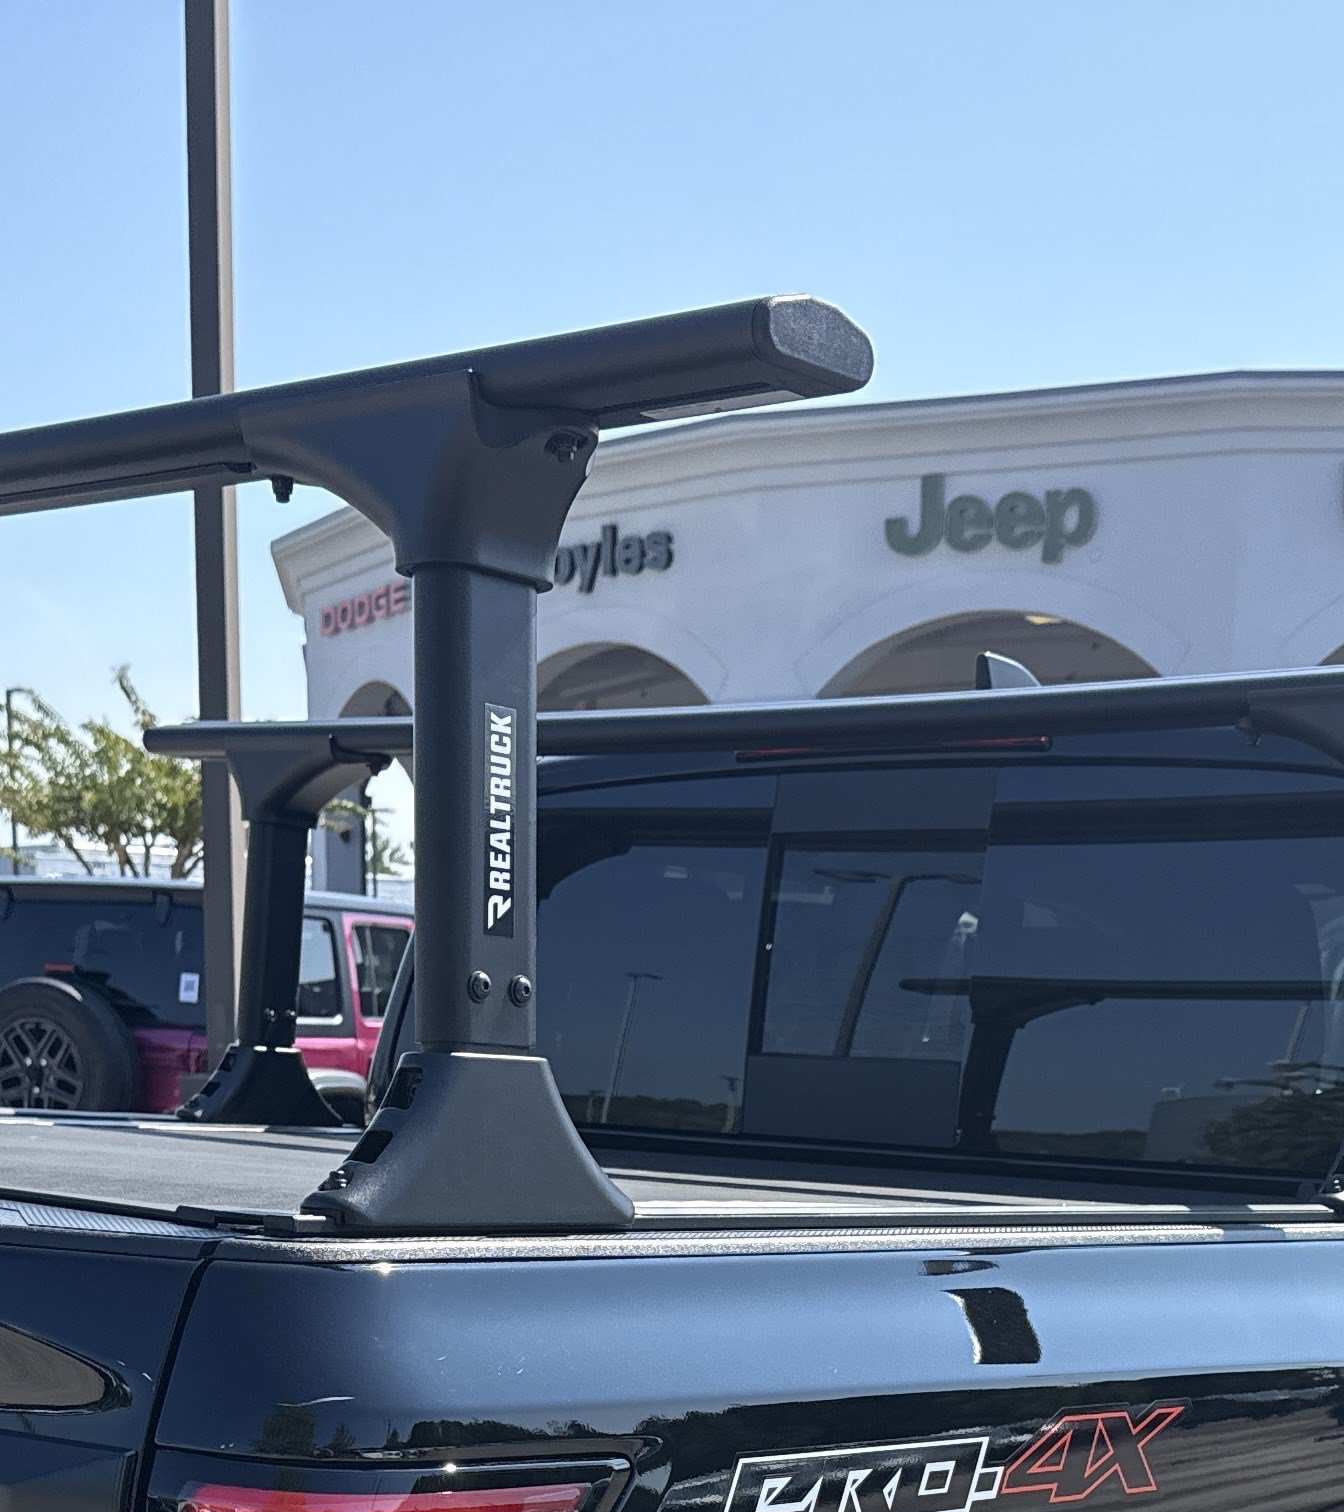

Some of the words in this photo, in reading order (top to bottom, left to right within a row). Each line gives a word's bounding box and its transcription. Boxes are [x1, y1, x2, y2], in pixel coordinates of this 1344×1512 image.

[555, 522, 674, 594] oyles
[884, 472, 1097, 564] Jeep
[319, 579, 409, 637] DODGE
[488, 711, 513, 892] REALTRUCK
